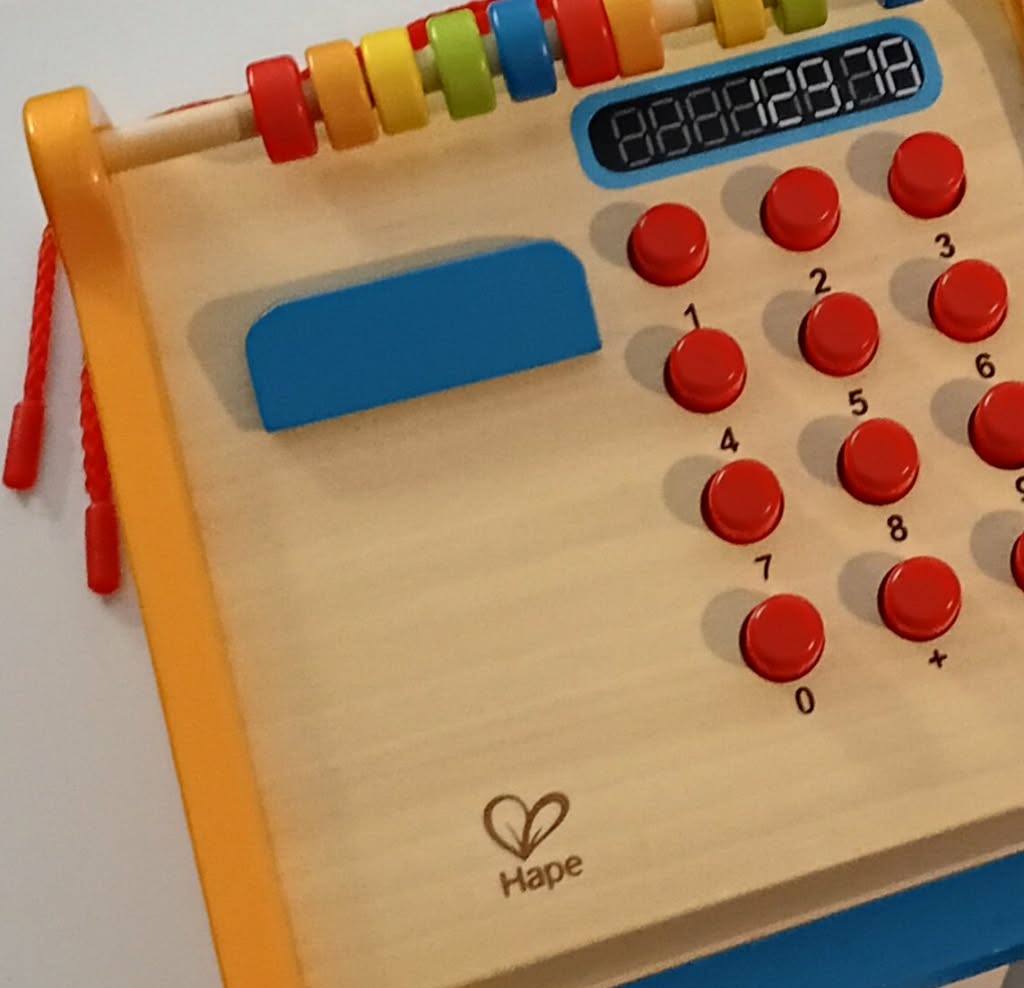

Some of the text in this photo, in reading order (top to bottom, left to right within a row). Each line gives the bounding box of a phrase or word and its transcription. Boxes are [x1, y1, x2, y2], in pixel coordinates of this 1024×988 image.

[748, 36, 922, 128] 129.78
[934, 232, 956, 259] 3
[809, 267, 832, 294] 2
[683, 303, 701, 328] 1
[974, 352, 996, 379] 6
[847, 388, 869, 417] 5
[718, 426, 740, 453] 4
[886, 514, 909, 542] 8
[754, 554, 774, 581] 7
[794, 686, 816, 715] 0
[499, 854, 584, 898] Hape
